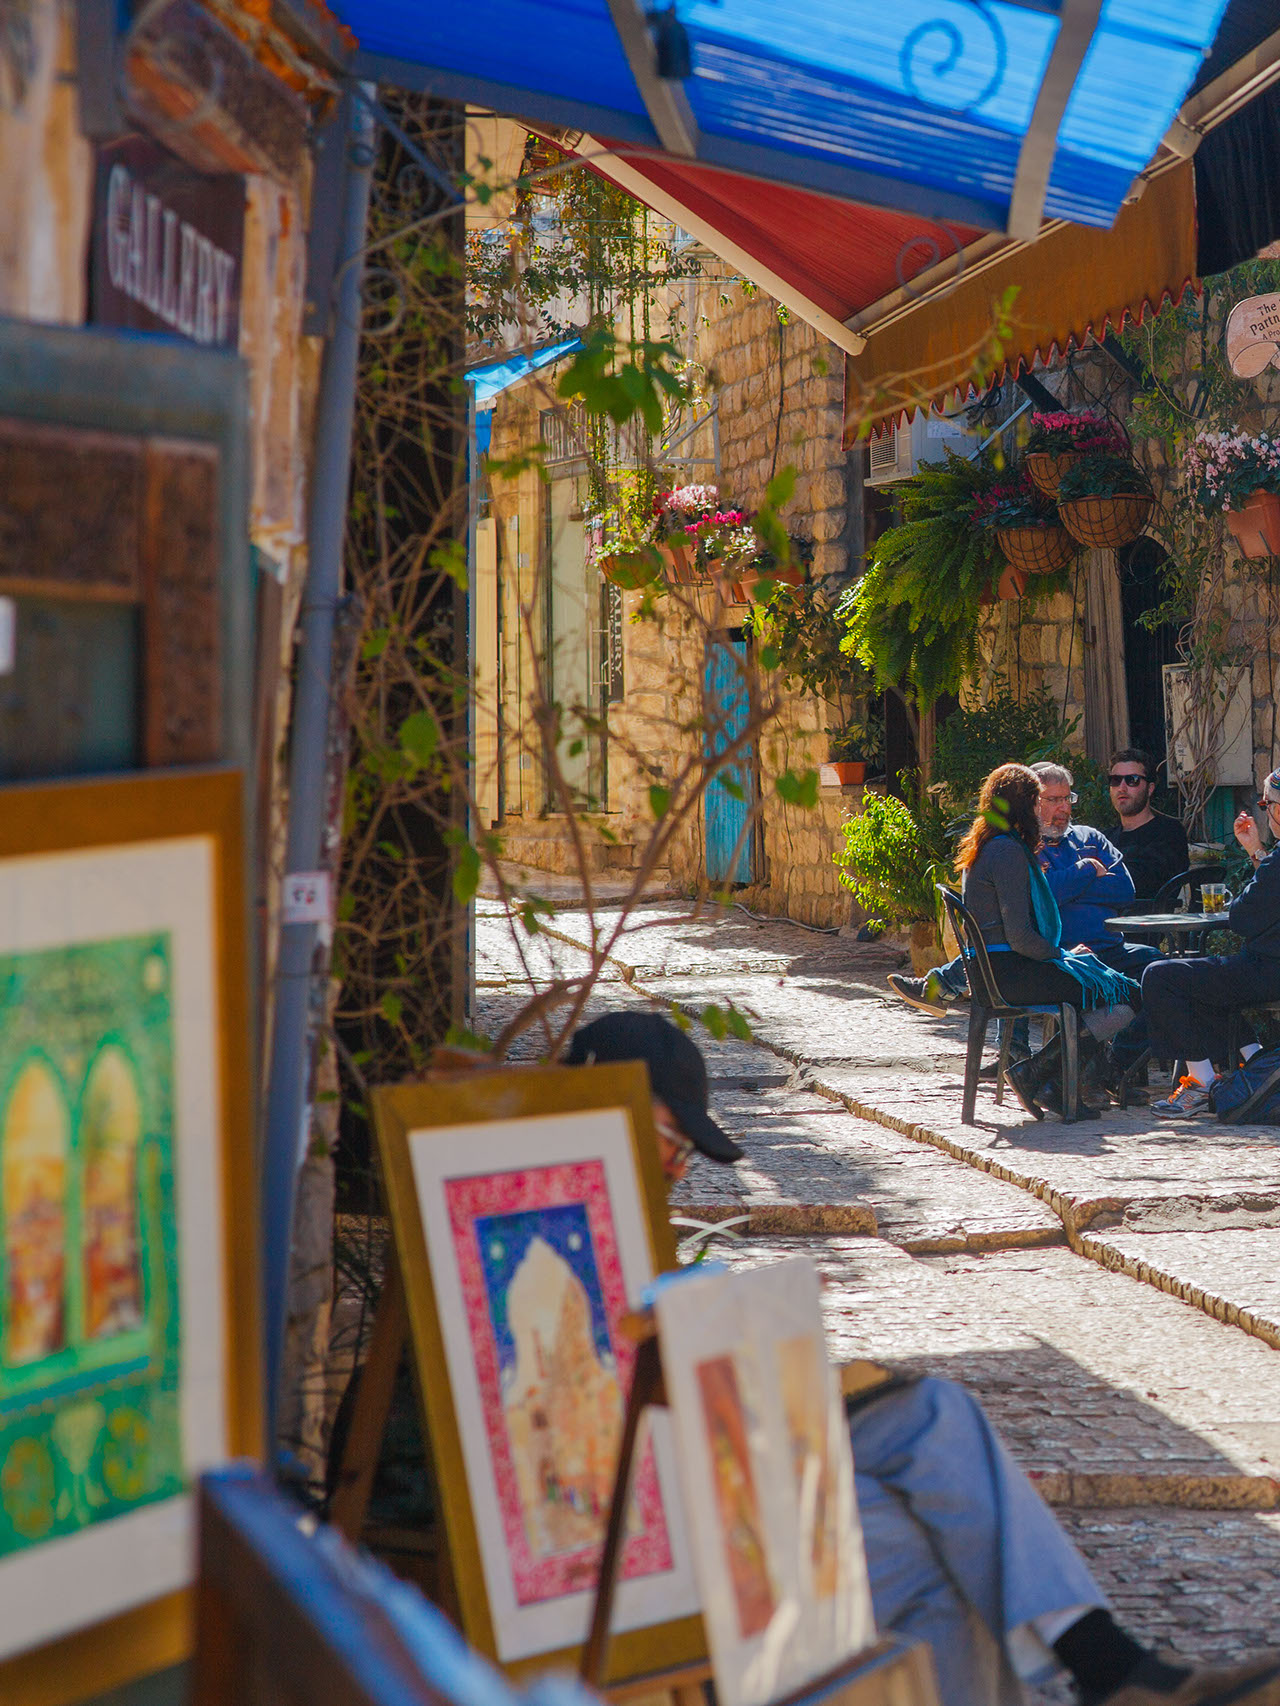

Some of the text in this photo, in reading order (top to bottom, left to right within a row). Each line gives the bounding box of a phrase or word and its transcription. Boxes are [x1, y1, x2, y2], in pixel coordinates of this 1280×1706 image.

[107, 163, 235, 344] GALLERY
[1256, 303, 1277, 316] The
[1262, 333, 1268, 341] A
